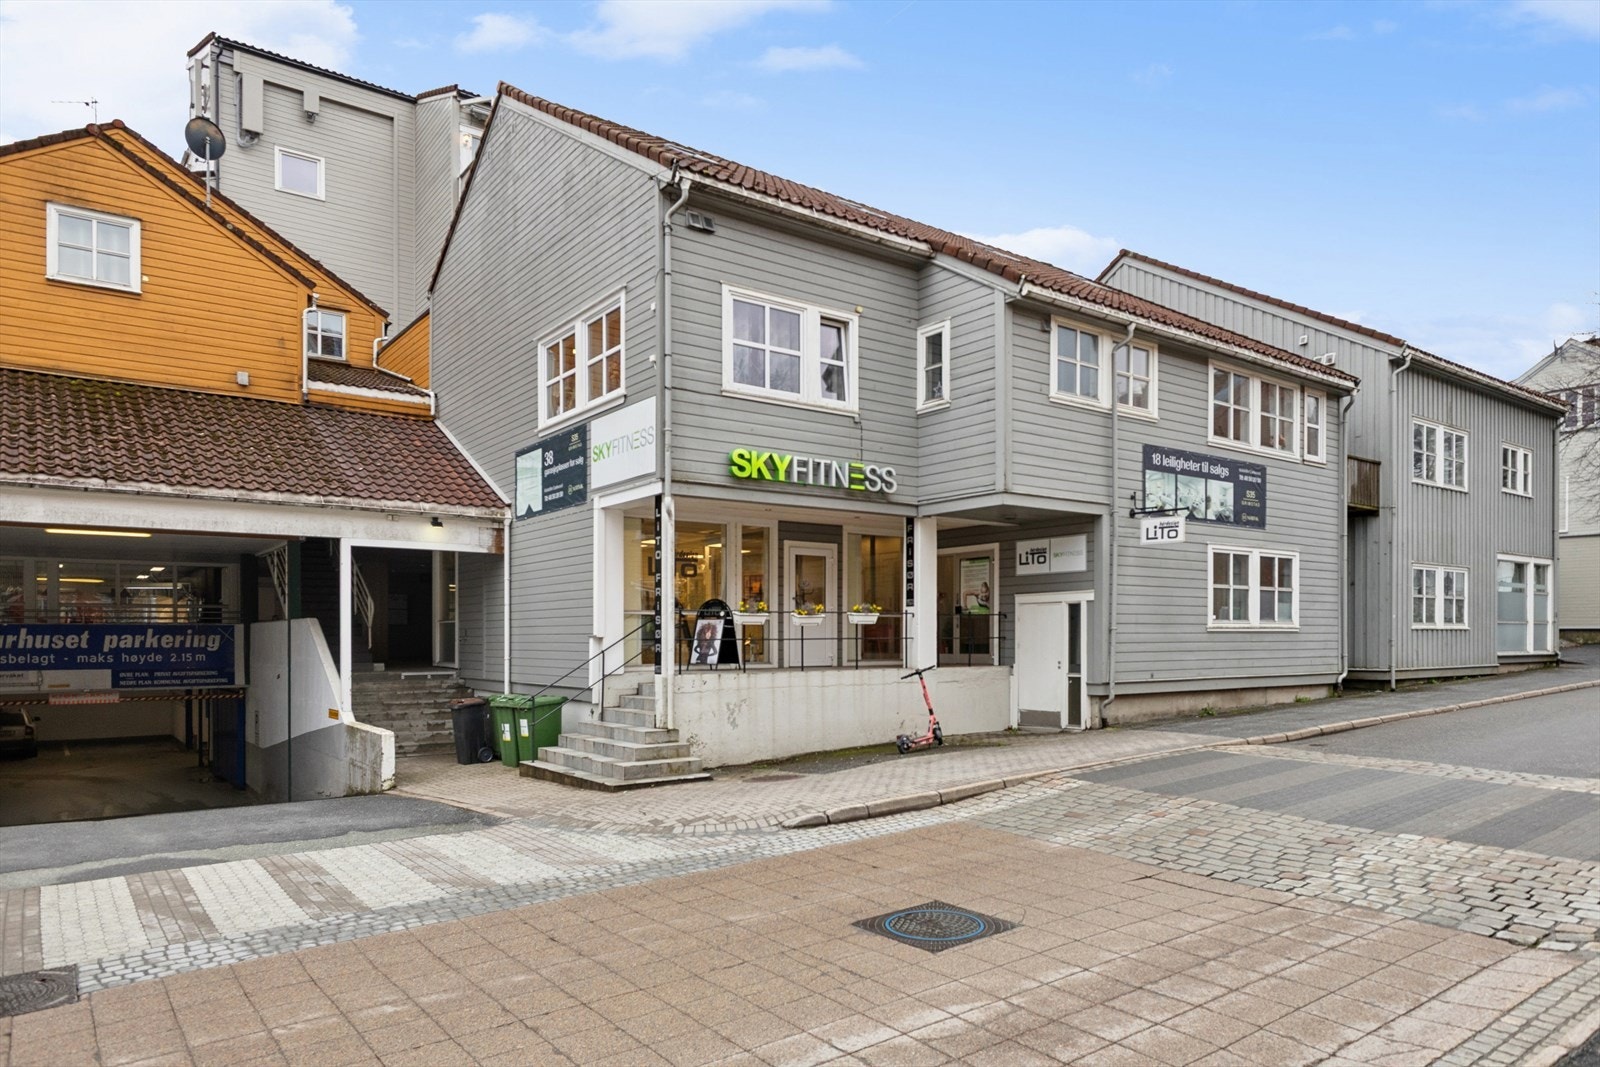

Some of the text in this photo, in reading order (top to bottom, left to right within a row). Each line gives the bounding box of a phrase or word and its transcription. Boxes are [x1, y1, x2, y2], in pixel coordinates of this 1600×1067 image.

[592, 426, 654, 463] SKYFITNESS
[544, 450, 553, 466] 38
[730, 447, 898, 494] SKYFITNESS
[1151, 452, 1162, 466] 18
[1162, 454, 1200, 472] leiligheter
[1201, 461, 1209, 473] til
[1209, 465, 1230, 479] salgs
[103, 628, 221, 652] parkering
[77, 652, 114, 663] maks
[121, 653, 163, 665] høyde
[170, 653, 192, 662] 2.15
[195, 653, 206, 661] m
